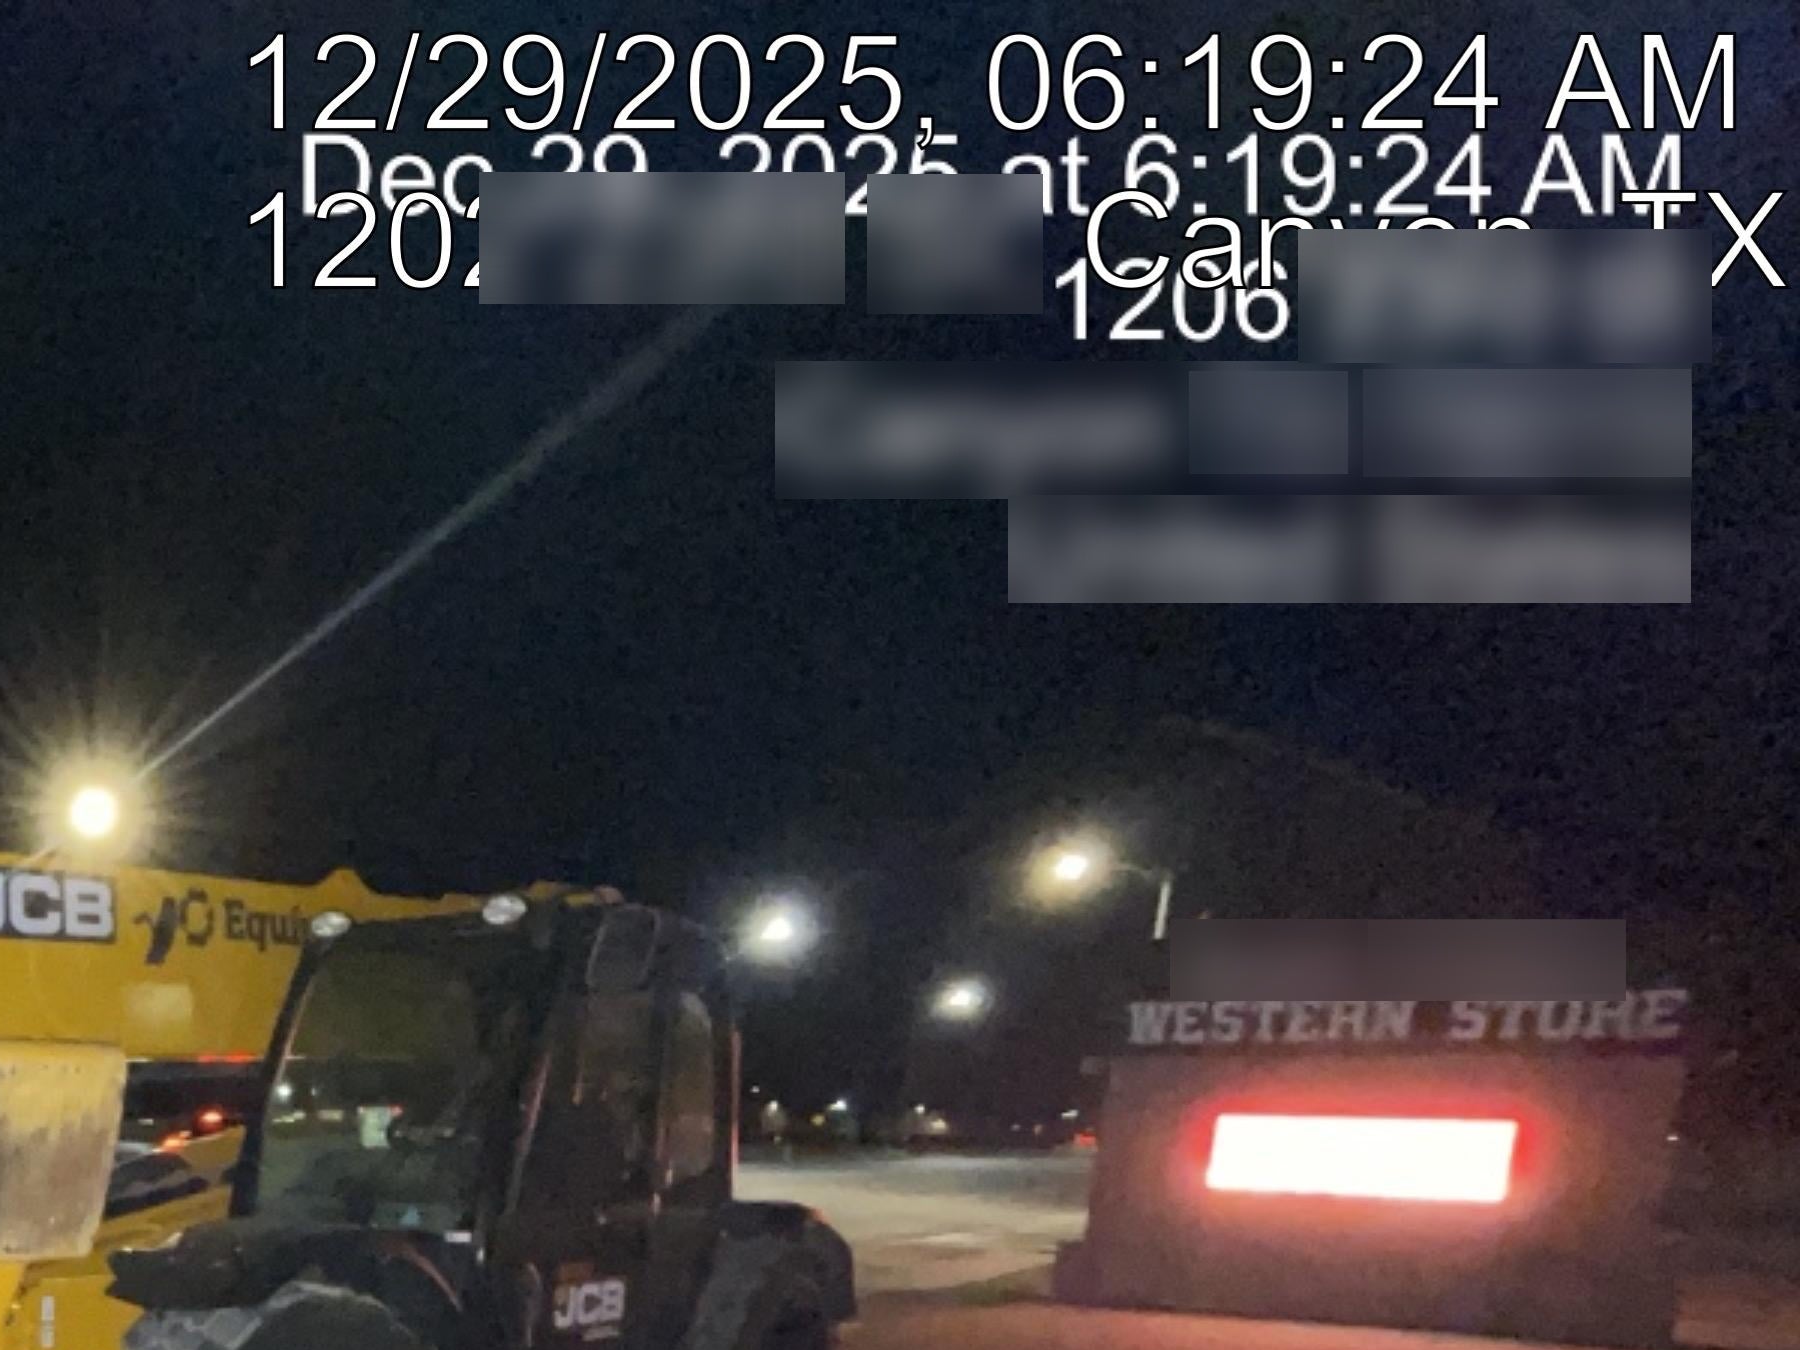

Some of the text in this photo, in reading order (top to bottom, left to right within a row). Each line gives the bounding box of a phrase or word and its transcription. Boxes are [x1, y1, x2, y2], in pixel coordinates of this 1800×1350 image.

[1126, 989, 1688, 1046] WESTERN STORE
[553, 1278, 625, 1329] JCB
